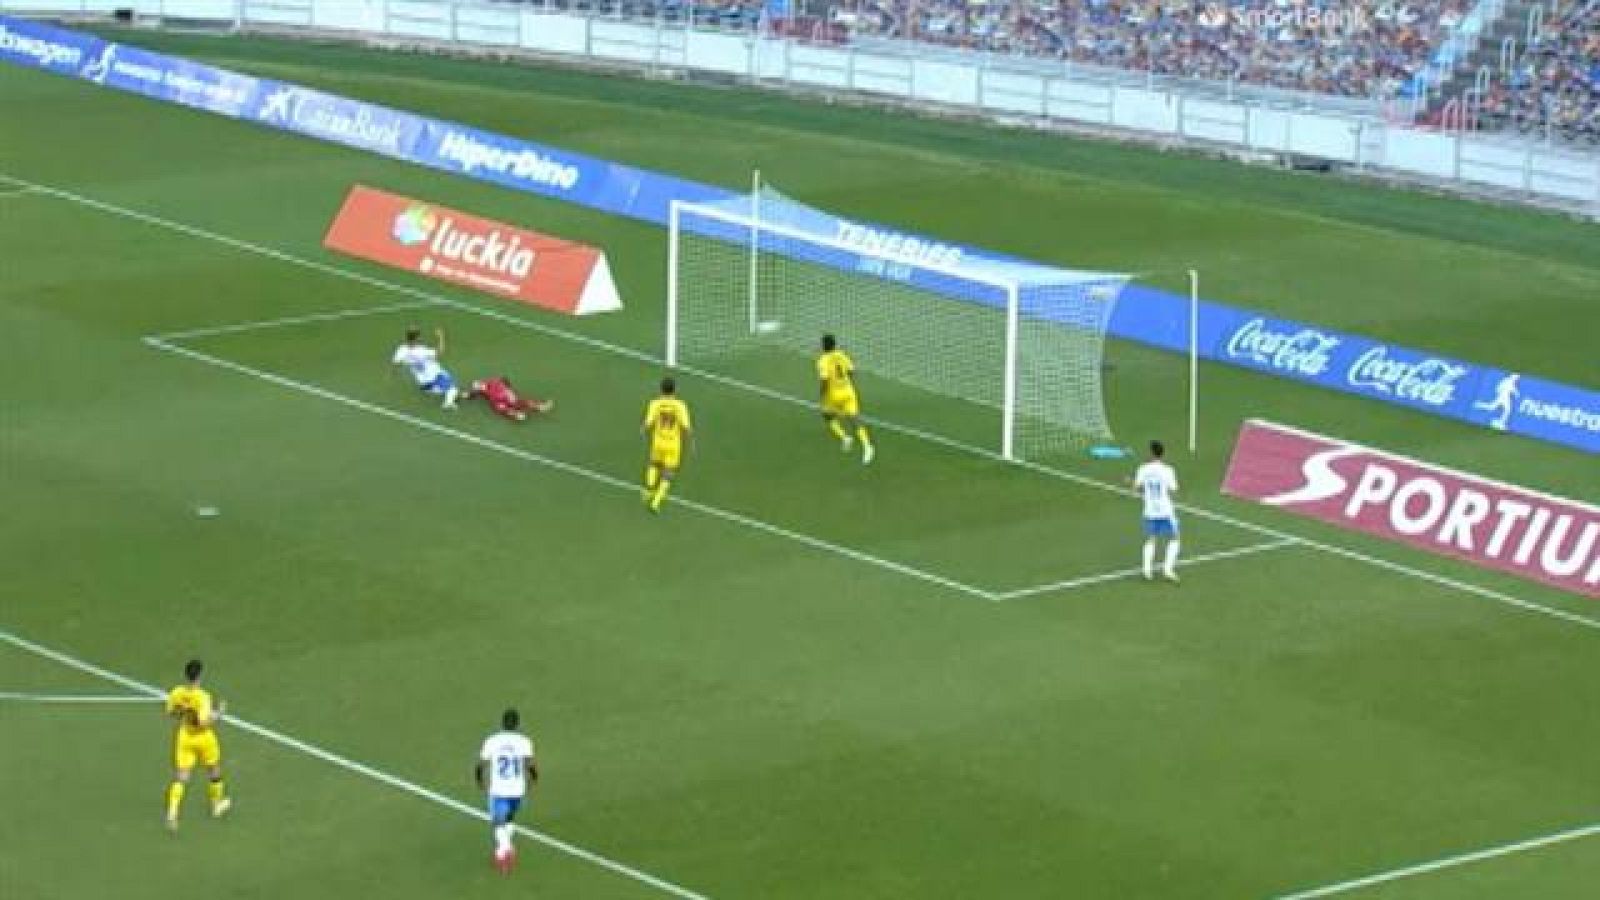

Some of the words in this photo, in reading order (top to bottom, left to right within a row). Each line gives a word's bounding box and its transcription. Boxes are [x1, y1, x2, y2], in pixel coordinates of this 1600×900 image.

[438, 131, 579, 190] HiperDino
[429, 217, 535, 278] luckia
[1227, 318, 1341, 376] Coca-Cola
[1348, 346, 1468, 404] Coca-Cola
[497, 754, 520, 779] 21
